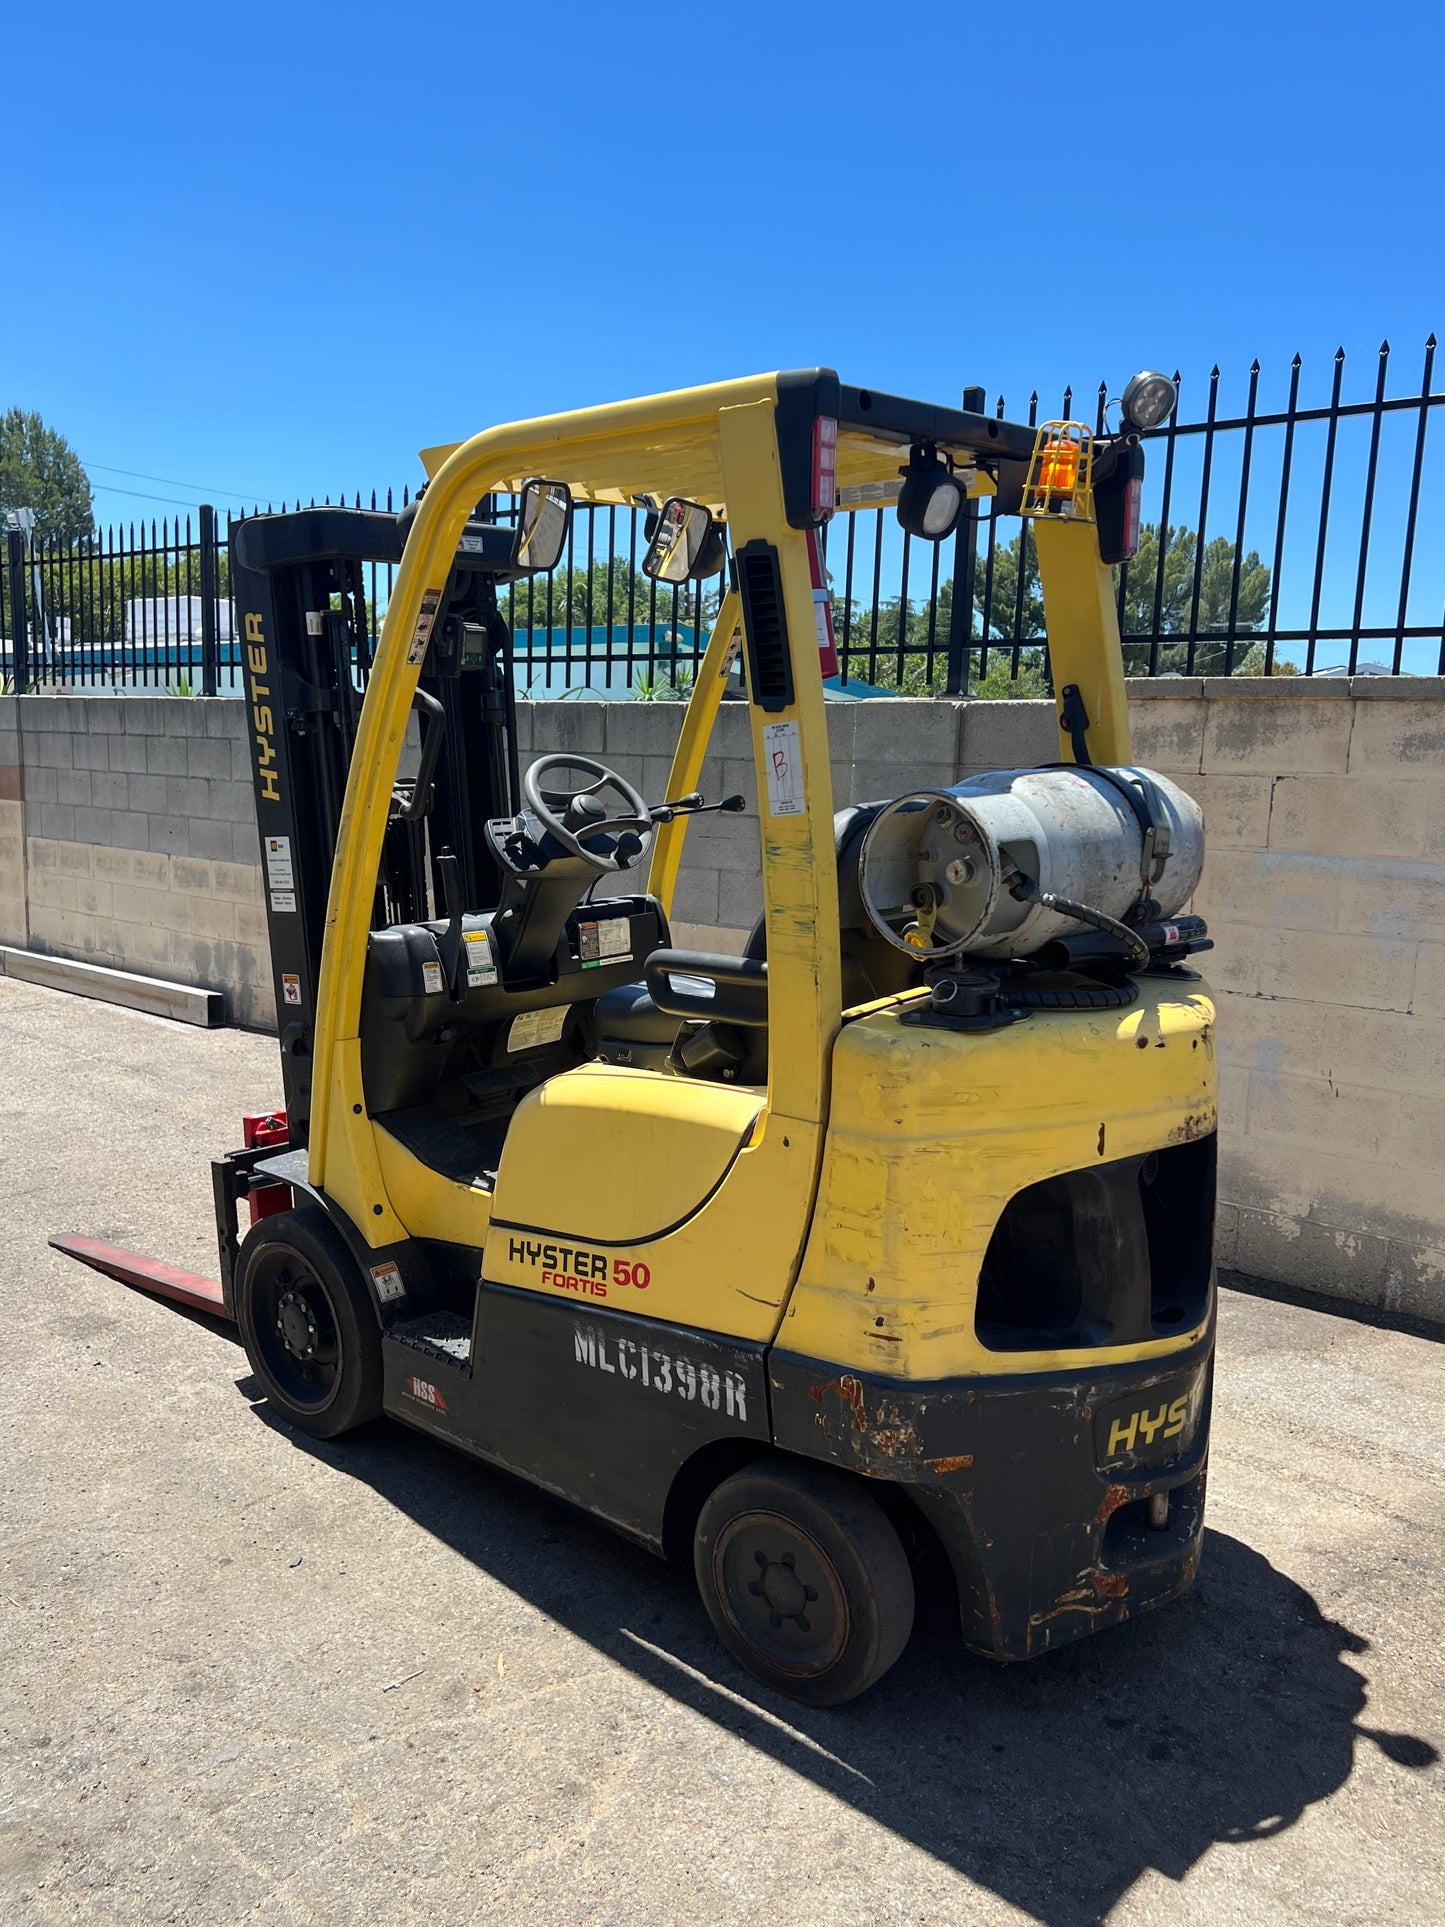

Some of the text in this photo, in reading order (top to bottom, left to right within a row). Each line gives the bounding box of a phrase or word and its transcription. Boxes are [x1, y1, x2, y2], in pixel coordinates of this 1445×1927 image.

[244, 612, 280, 801] HYSTER
[772, 750, 789, 781] B
[509, 1238, 651, 1290] HYSTER 50
[541, 1271, 607, 1298] FORTIS
[411, 1376, 436, 1404] HSS
